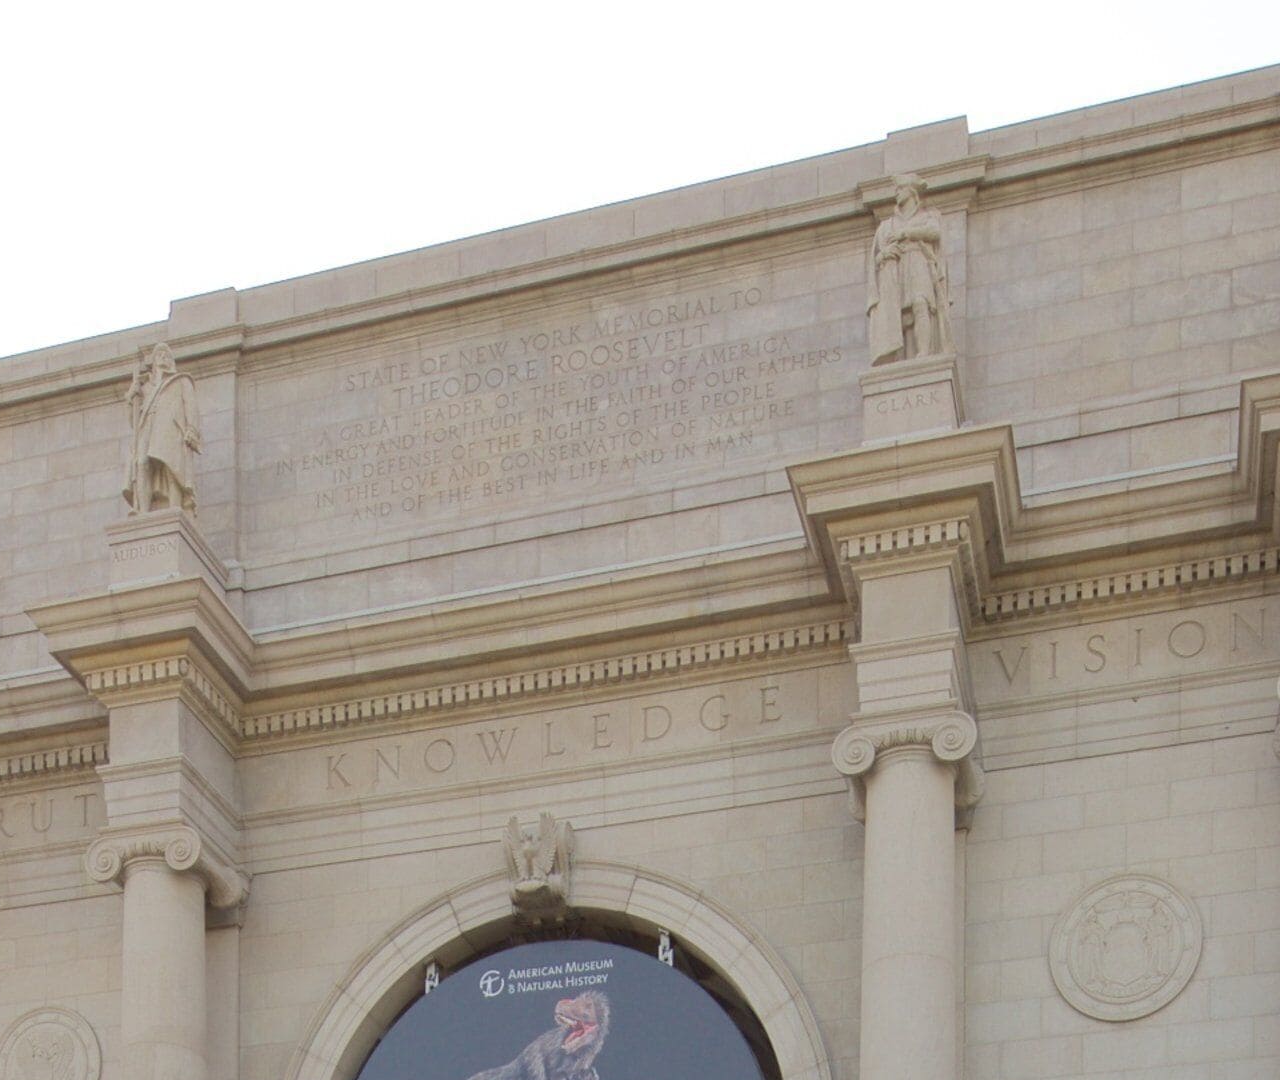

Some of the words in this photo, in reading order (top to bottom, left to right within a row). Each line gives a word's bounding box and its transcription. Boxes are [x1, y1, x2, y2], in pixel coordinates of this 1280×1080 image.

[345, 362, 410, 392] STATE
[421, 354, 448, 376] OF
[459, 340, 508, 367] NEW
[520, 325, 582, 354] YORK
[593, 297, 721, 337] MEMORIAL
[729, 287, 762, 308] TO
[393, 359, 538, 408] THEODORE
[551, 323, 710, 374] ROOSEVELT
[276, 459, 293, 476] IN
[302, 444, 370, 471] ENERGY
[376, 434, 416, 456] AND
[424, 411, 526, 443] FORTITUDE
[536, 405, 555, 423] IN
[566, 395, 598, 417] THE
[608, 384, 663, 407] FAITH
[671, 376, 697, 395] OF
[704, 366, 748, 388] OUR
[757, 346, 842, 377] FATHERS
[333, 466, 352, 484] IN
[363, 449, 442, 478] DEFENSE
[451, 442, 476, 460] OF
[484, 432, 521, 453] THE
[532, 416, 607, 444] RIGHTS
[616, 407, 642, 427] OF
[651, 399, 690, 421] THE
[700, 382, 777, 411] PEOPLE
[340, 415, 402, 441] GREAT
[414, 399, 483, 427] LEADER
[495, 392, 520, 409] OF
[530, 381, 567, 398] THE
[580, 363, 649, 392] YOUTH
[662, 356, 688, 375] OF
[696, 335, 792, 370] AMERICA
[876, 391, 937, 414] CLARK
[315, 490, 335, 508] IN
[344, 481, 379, 503] THE
[390, 470, 438, 492] LOVE
[447, 460, 490, 484] AND
[500, 427, 659, 472] CONSERVATION
[671, 419, 697, 438] OF
[710, 400, 795, 429] NATURE
[352, 501, 392, 522] AND
[401, 494, 425, 512] OF
[437, 483, 473, 504] THE
[482, 474, 527, 497] BEST
[537, 467, 558, 486] IN
[569, 458, 609, 480] LIFE
[620, 448, 665, 470] AND
[675, 440, 696, 460] IN
[707, 430, 753, 454] MAN
[112, 538, 178, 563] AUDUBON
[991, 607, 1269, 687] VISION
[325, 684, 783, 791] KNOWLEDGE
[508, 966, 563, 980] AMERICAN
[565, 958, 614, 974] MUSEUM
[517, 980, 564, 993] NATURAL
[565, 973, 609, 987] HISTORY
